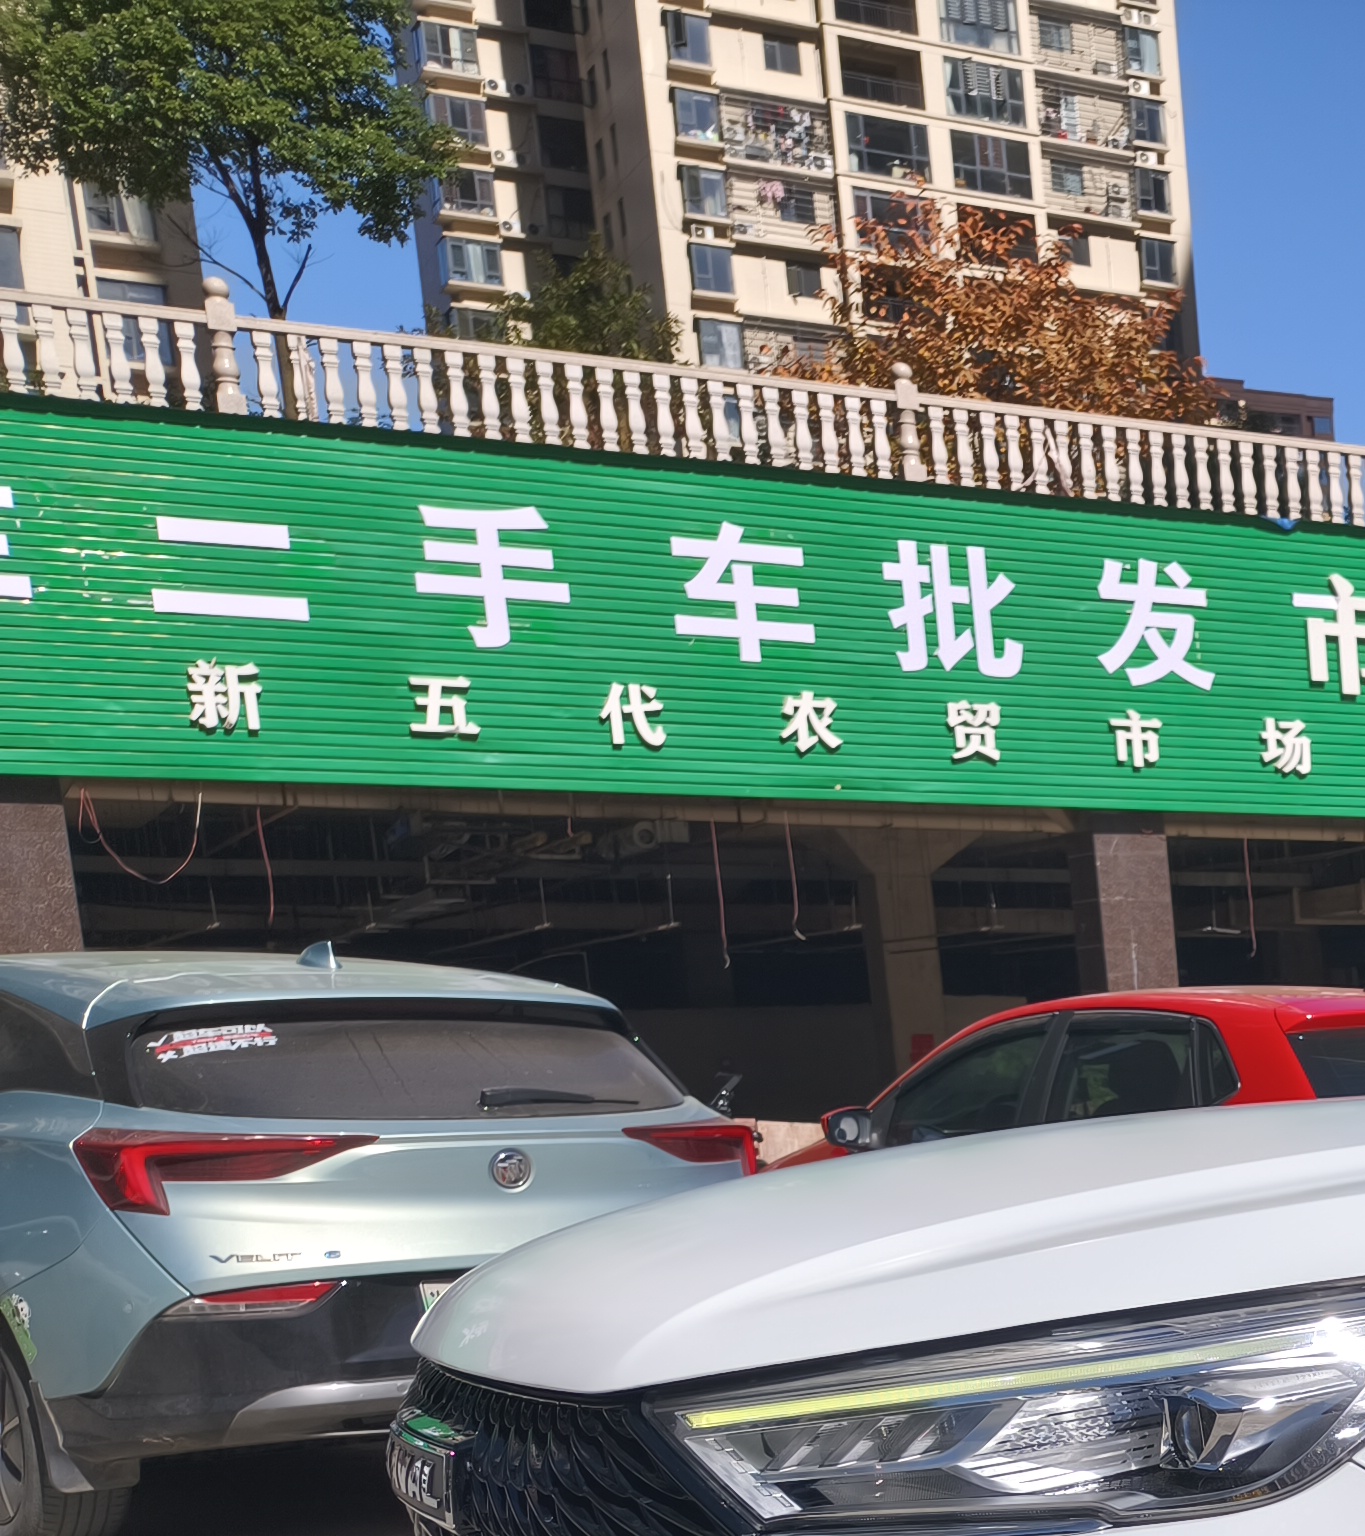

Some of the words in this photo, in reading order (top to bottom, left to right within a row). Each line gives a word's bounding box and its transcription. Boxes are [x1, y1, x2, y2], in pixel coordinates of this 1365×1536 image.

[187, 657, 1312, 776] 新五代农贸市场
